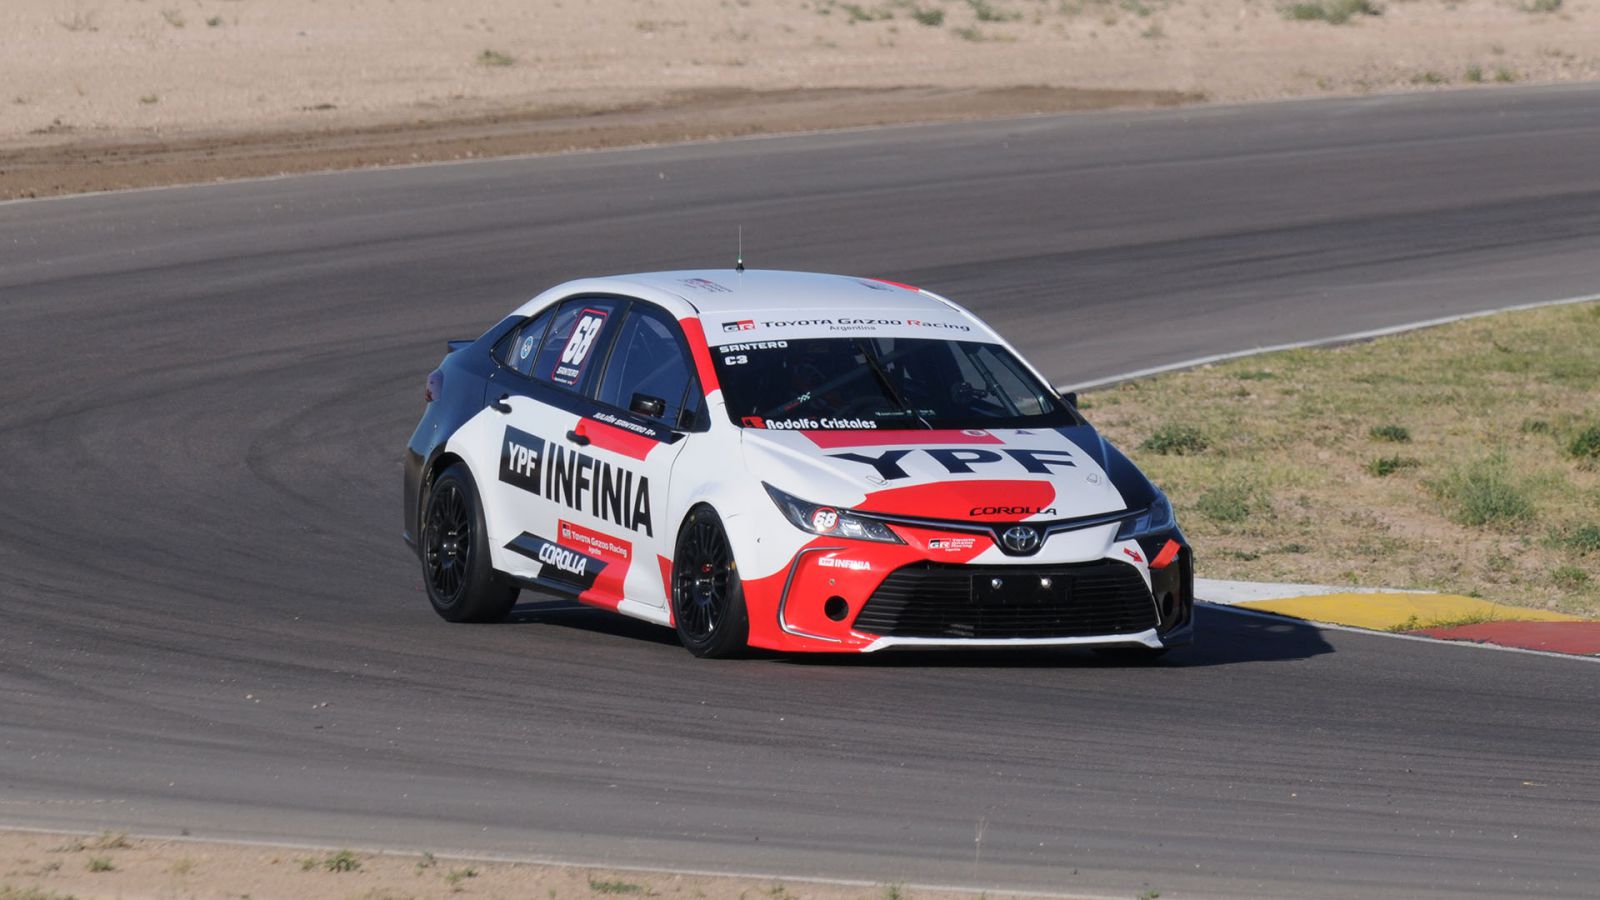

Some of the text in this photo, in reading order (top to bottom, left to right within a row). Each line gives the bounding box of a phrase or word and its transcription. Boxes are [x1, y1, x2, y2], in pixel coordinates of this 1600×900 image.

[722, 320, 755, 332] GR
[760, 317, 970, 332] TOYOTA GAZOO Racing
[561, 315, 602, 365] 68
[719, 341, 788, 353] SANTERO
[724, 355, 748, 365] C3
[765, 418, 819, 430] Rodolfo
[820, 418, 877, 429] Cristales
[824, 449, 1077, 481] YPF
[508, 441, 654, 538] YPF INFINIA
[969, 506, 1057, 517] COROLLA
[813, 511, 838, 532] 68
[538, 543, 587, 576] COROLLA
[835, 558, 871, 570] INFINIA
